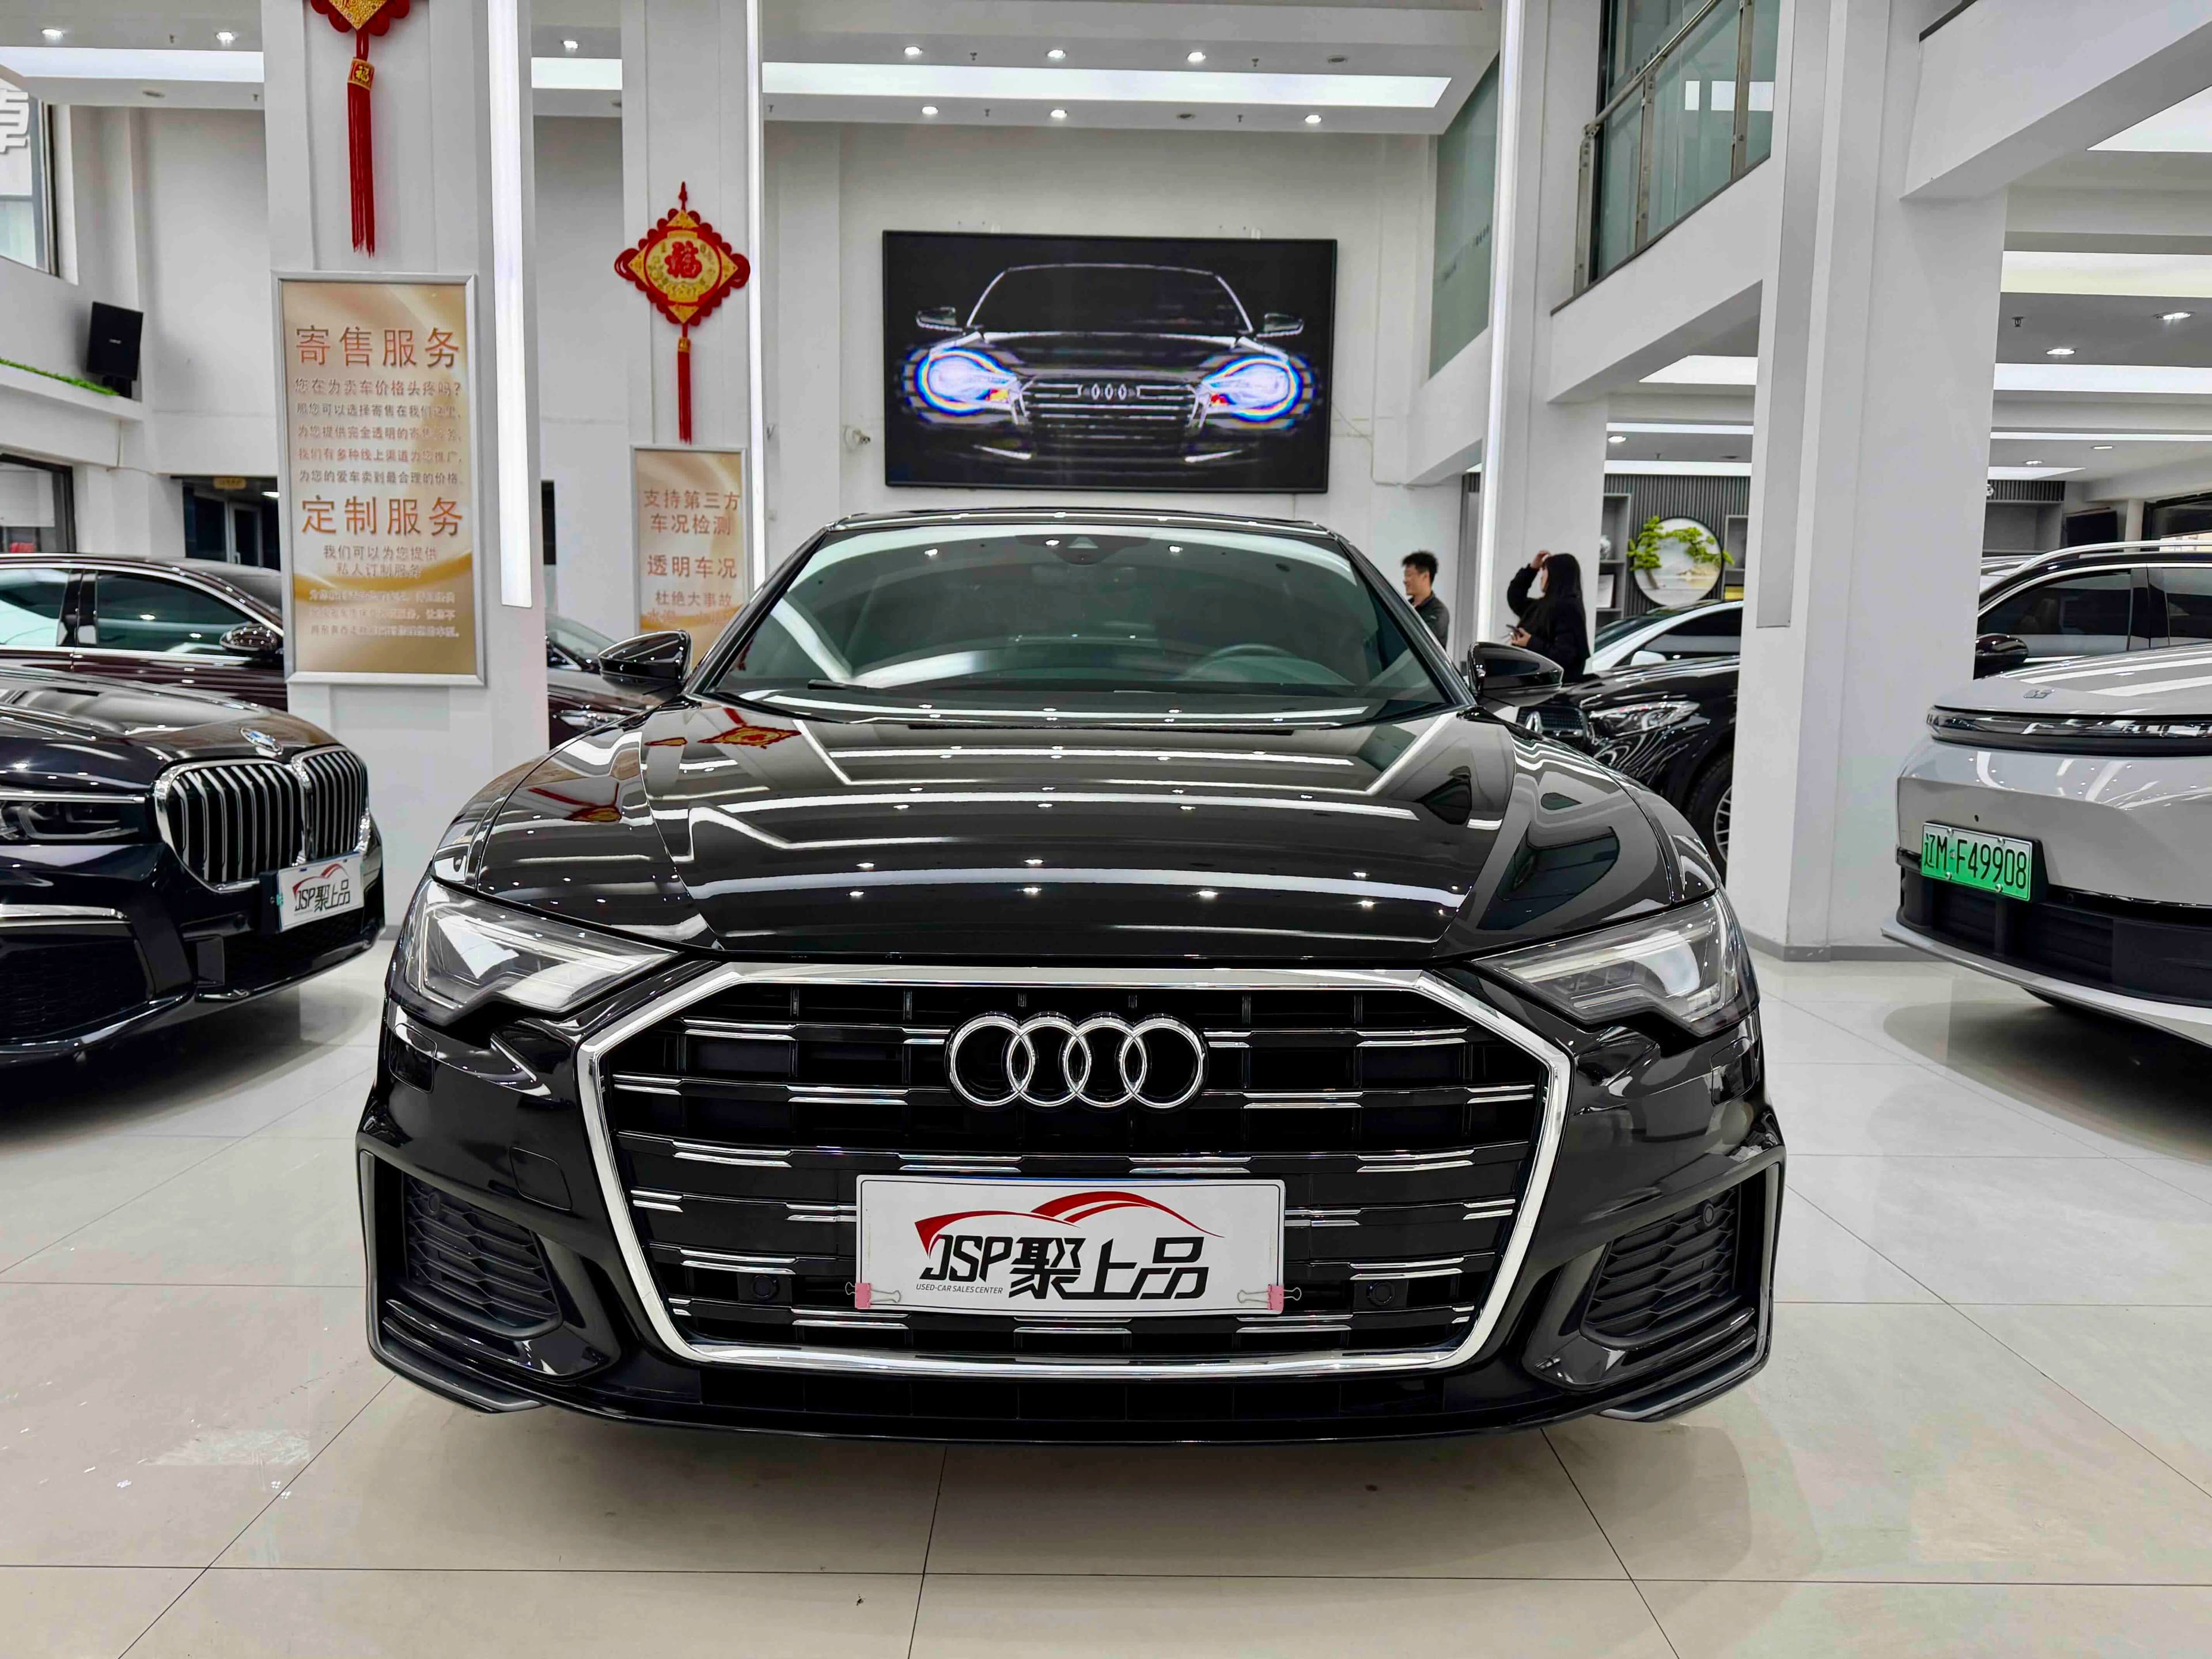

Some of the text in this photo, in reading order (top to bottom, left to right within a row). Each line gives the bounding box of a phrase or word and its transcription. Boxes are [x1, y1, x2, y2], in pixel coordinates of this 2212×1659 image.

[665, 240, 703, 279] 福
[296, 325, 459, 368] 寄售服务
[643, 488, 740, 511] 支持第三方
[302, 494, 463, 536] 定制服务
[650, 513, 731, 535] 车况检测
[323, 544, 437, 562] 我们可以为您提供
[647, 554, 737, 578] 透明车况
[655, 589, 732, 607] 杜绝大事故
[916, 1283, 1003, 1294] USED-CAR SALES CENTER
